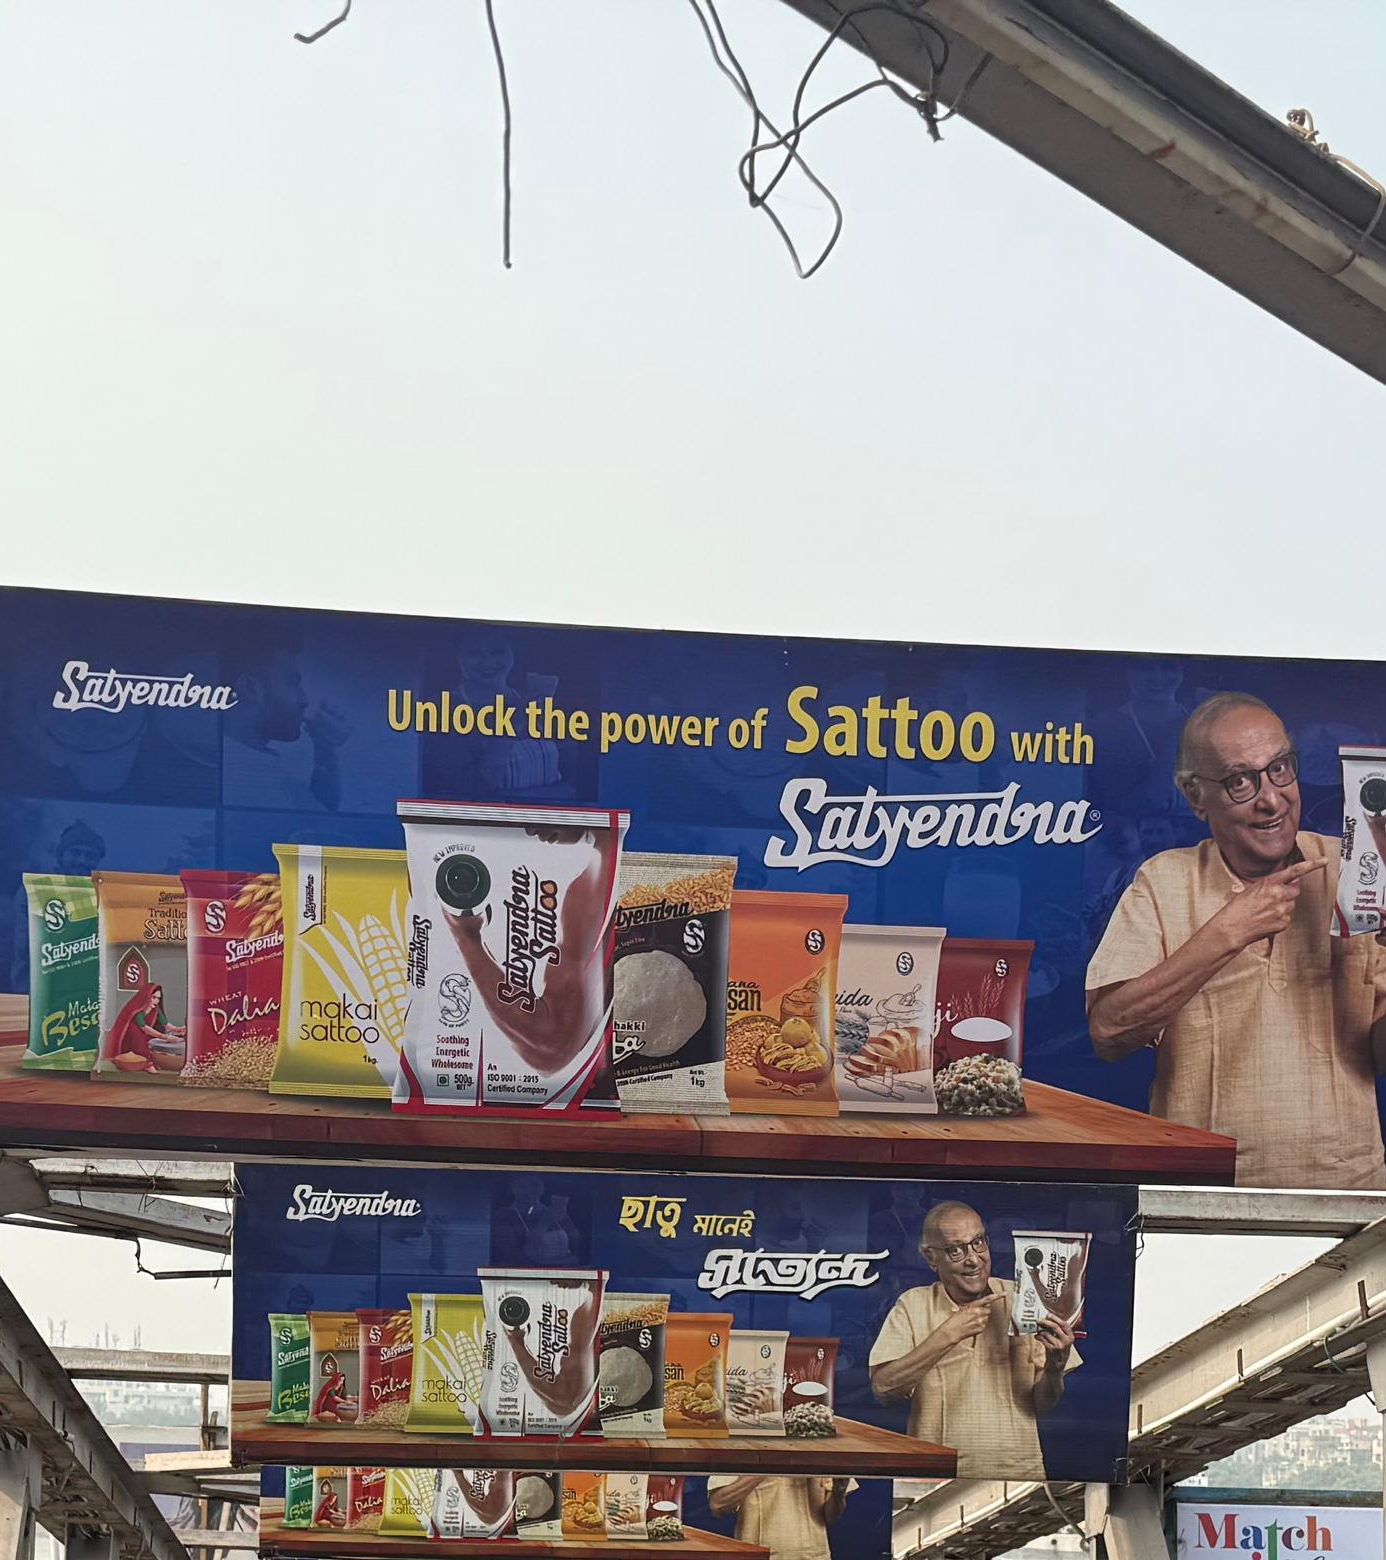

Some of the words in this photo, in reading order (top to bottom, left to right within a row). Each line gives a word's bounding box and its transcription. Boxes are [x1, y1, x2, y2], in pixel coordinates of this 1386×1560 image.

[53, 661, 239, 713] Satyendra
[387, 688, 516, 740] Unlock
[525, 697, 591, 742] the
[600, 709, 718, 755] power
[728, 715, 767, 751] of
[785, 686, 995, 764] Sattoo
[1011, 721, 1095, 766] with
[149, 907, 187, 919] Traditio
[529, 872, 561, 966] Sattoo
[614, 899, 696, 934] tyendra
[41, 933, 100, 967] Satyend
[225, 931, 285, 964] Satyend
[727, 981, 759, 990] ana
[208, 990, 242, 1005] WHEAT
[300, 993, 379, 1021] makai
[727, 990, 762, 1012] san
[835, 988, 874, 1007] ida
[207, 996, 280, 1036] Dalia
[614, 1020, 646, 1031] hakki
[933, 1002, 959, 1039] ji
[299, 1020, 380, 1045] sattoo
[436, 1035, 470, 1046] Soothing
[435, 1047, 470, 1058] Energetic
[431, 1059, 474, 1070] Wholesome
[487, 1063, 497, 1071] An
[487, 1084, 516, 1094] Certified
[516, 1085, 548, 1096] Company
[618, 1195, 687, 1239] ছাতু
[693, 1209, 756, 1238] মানেই
[664, 1367, 685, 1381] san
[1194, 1512, 1333, 1556] Match
